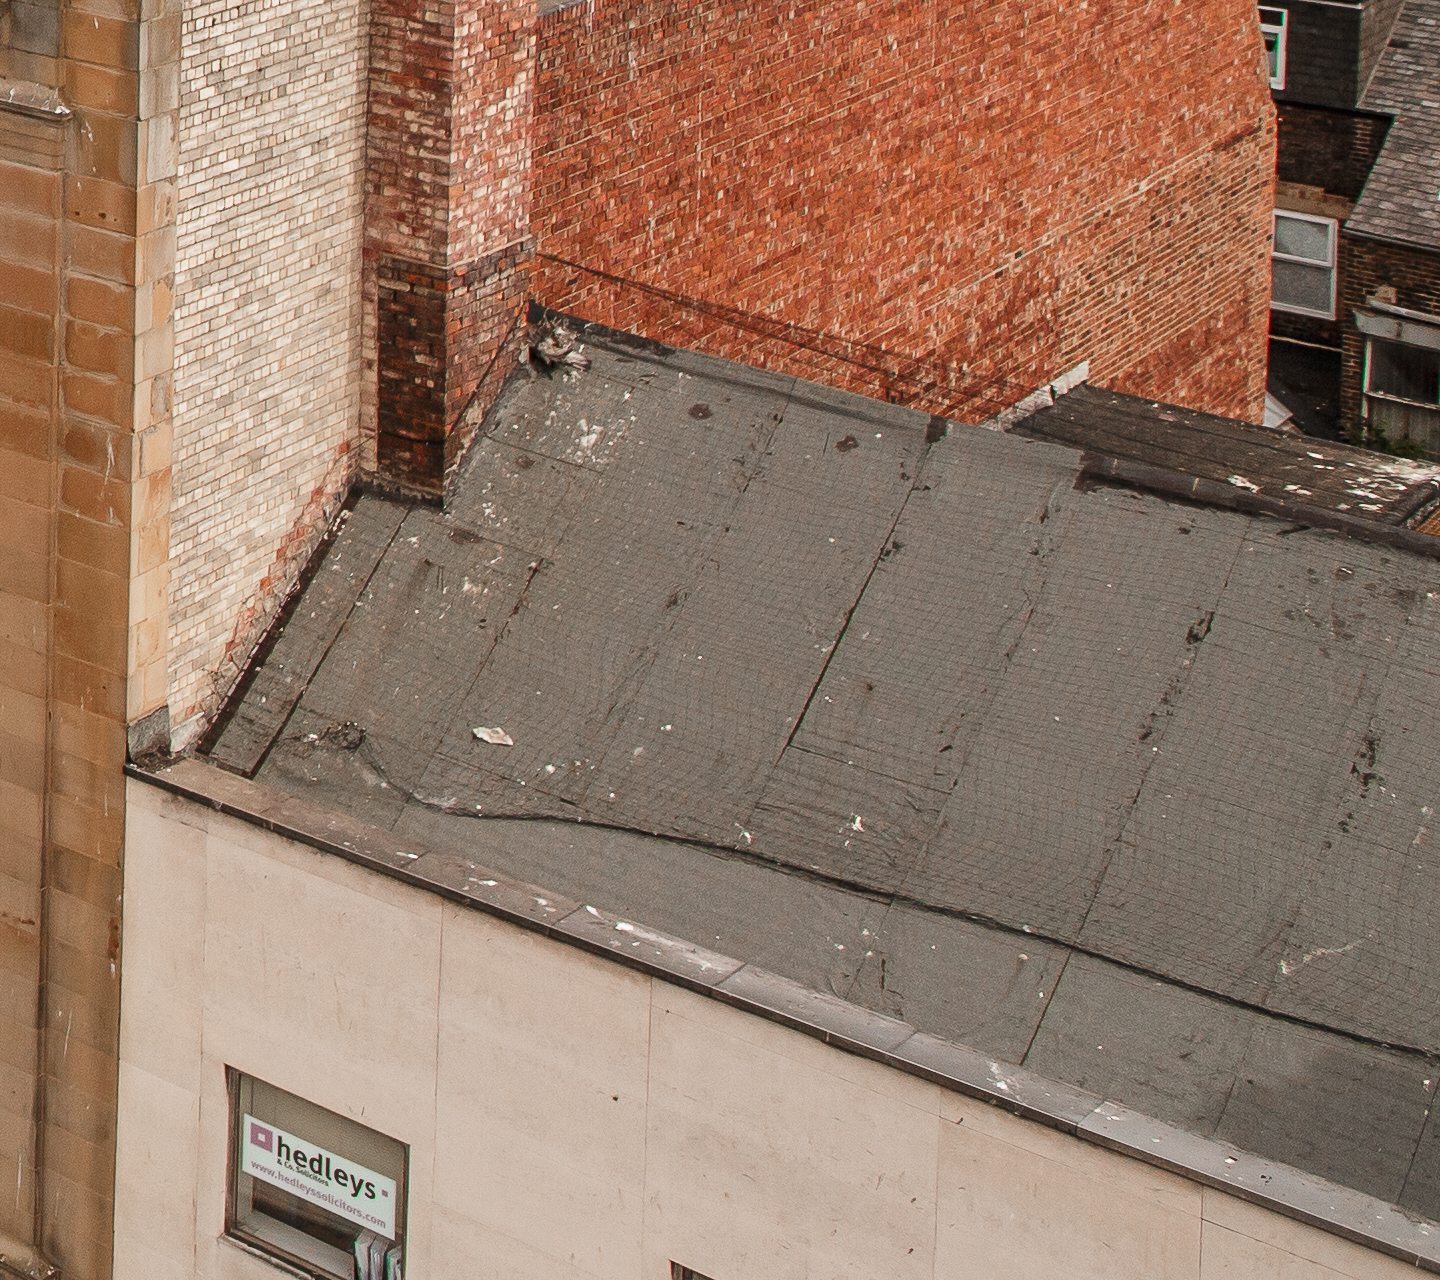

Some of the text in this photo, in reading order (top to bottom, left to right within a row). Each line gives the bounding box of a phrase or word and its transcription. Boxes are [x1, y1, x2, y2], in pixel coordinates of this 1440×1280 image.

[251, 1160, 386, 1229] www.hedleyssolicitors.com
[277, 1135, 376, 1200] hedleys
[277, 1158, 283, 1166] &
[296, 1166, 330, 1187] Solicitors
